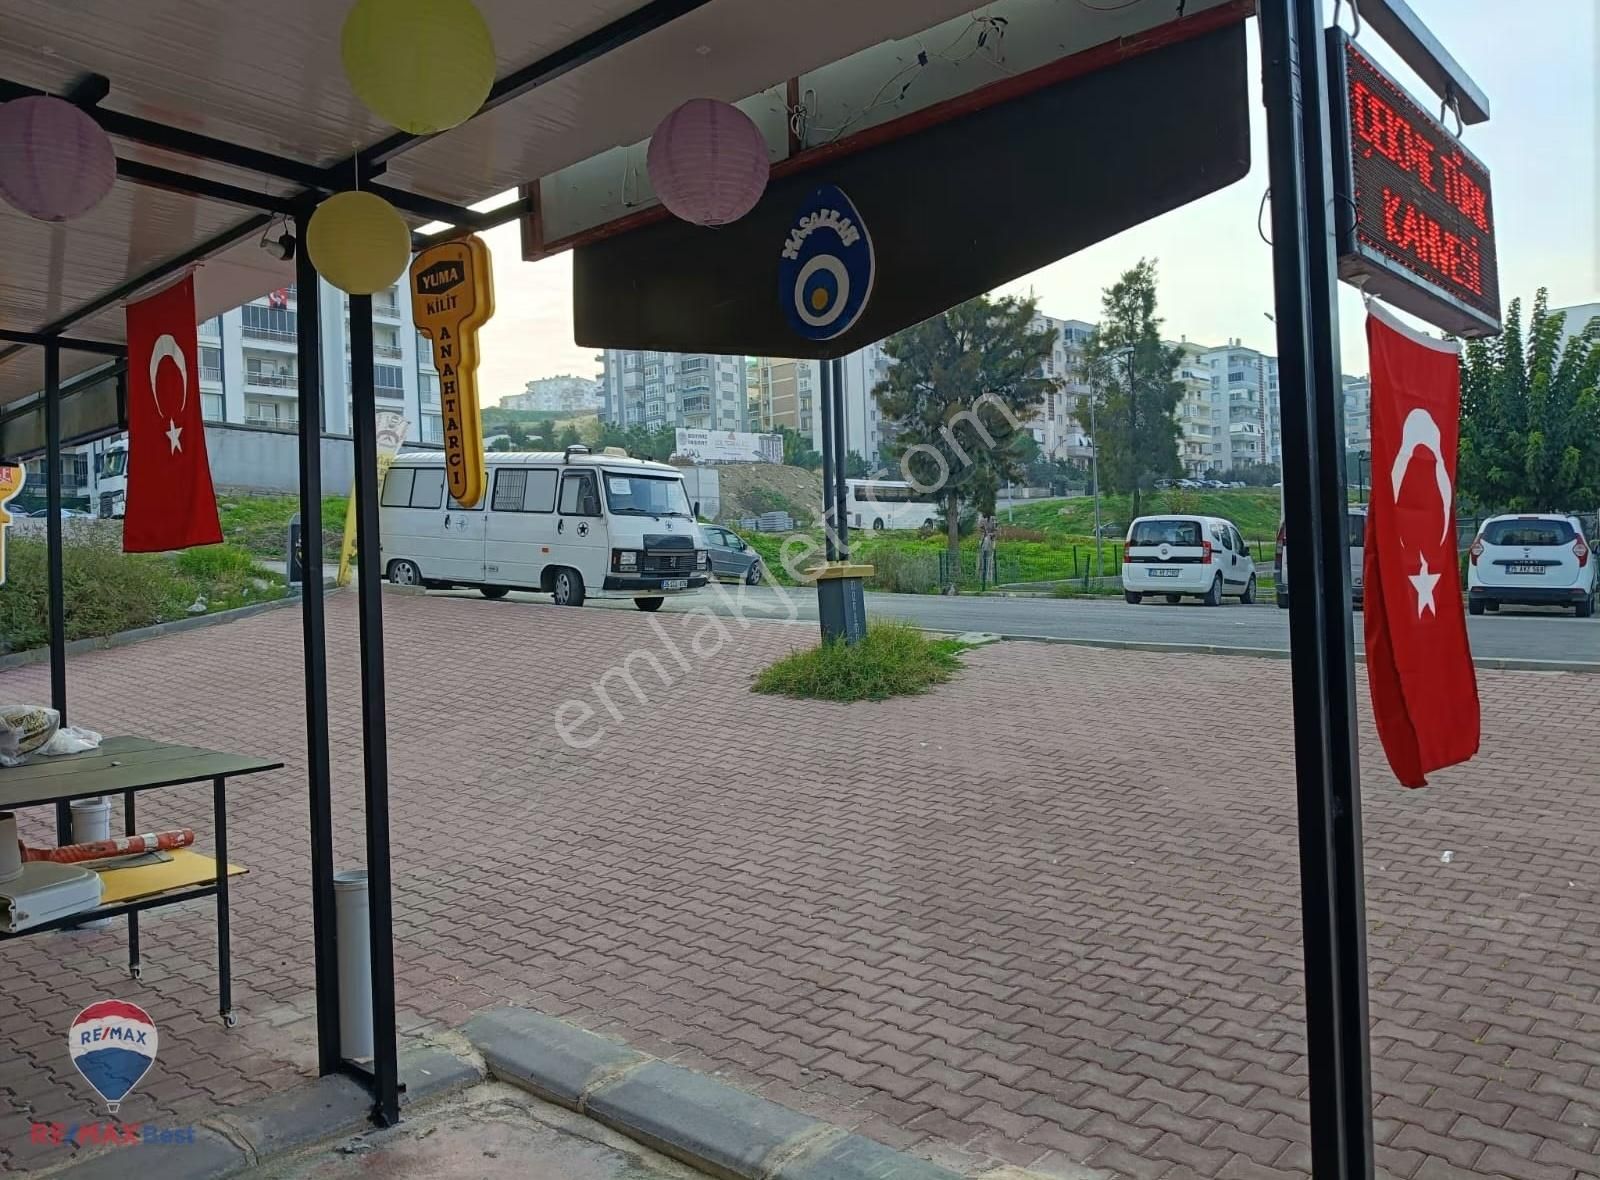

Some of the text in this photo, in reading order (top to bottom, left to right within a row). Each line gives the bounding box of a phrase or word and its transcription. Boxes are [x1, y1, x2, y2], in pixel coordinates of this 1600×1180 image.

[1440, 151, 1490, 234] TÜRK
[422, 267, 459, 289] YUMA
[1382, 187, 1483, 296] KAHVESİ
[426, 294, 458, 316] KİLİT
[439, 327, 461, 485] ANAHTARCI
